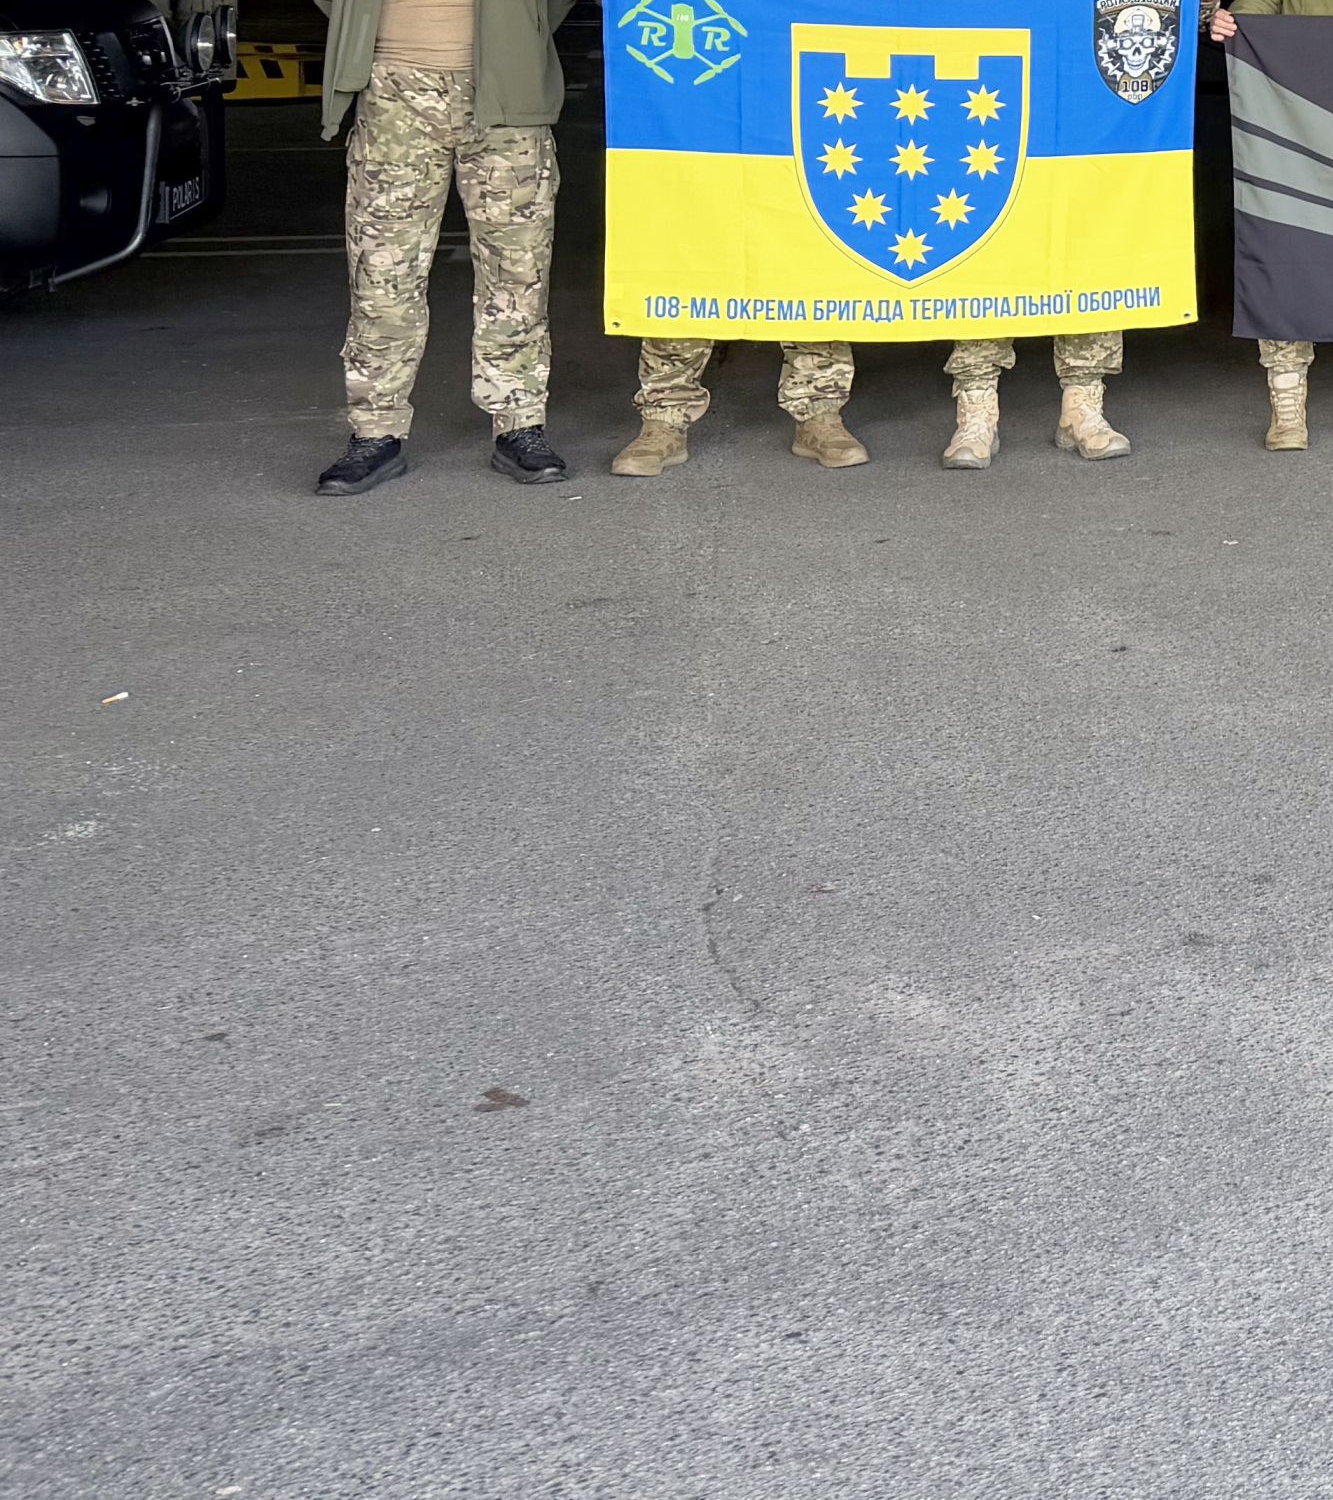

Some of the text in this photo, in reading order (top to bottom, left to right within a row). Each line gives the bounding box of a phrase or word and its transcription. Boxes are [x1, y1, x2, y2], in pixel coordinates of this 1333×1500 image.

[1122, 80, 1149, 93] 108
[644, 286, 1161, 323] 108-МА ОКРЕМА БРИГАДА ТЕРИТОРІАЛЬНОЇ ОБОРОНИ
